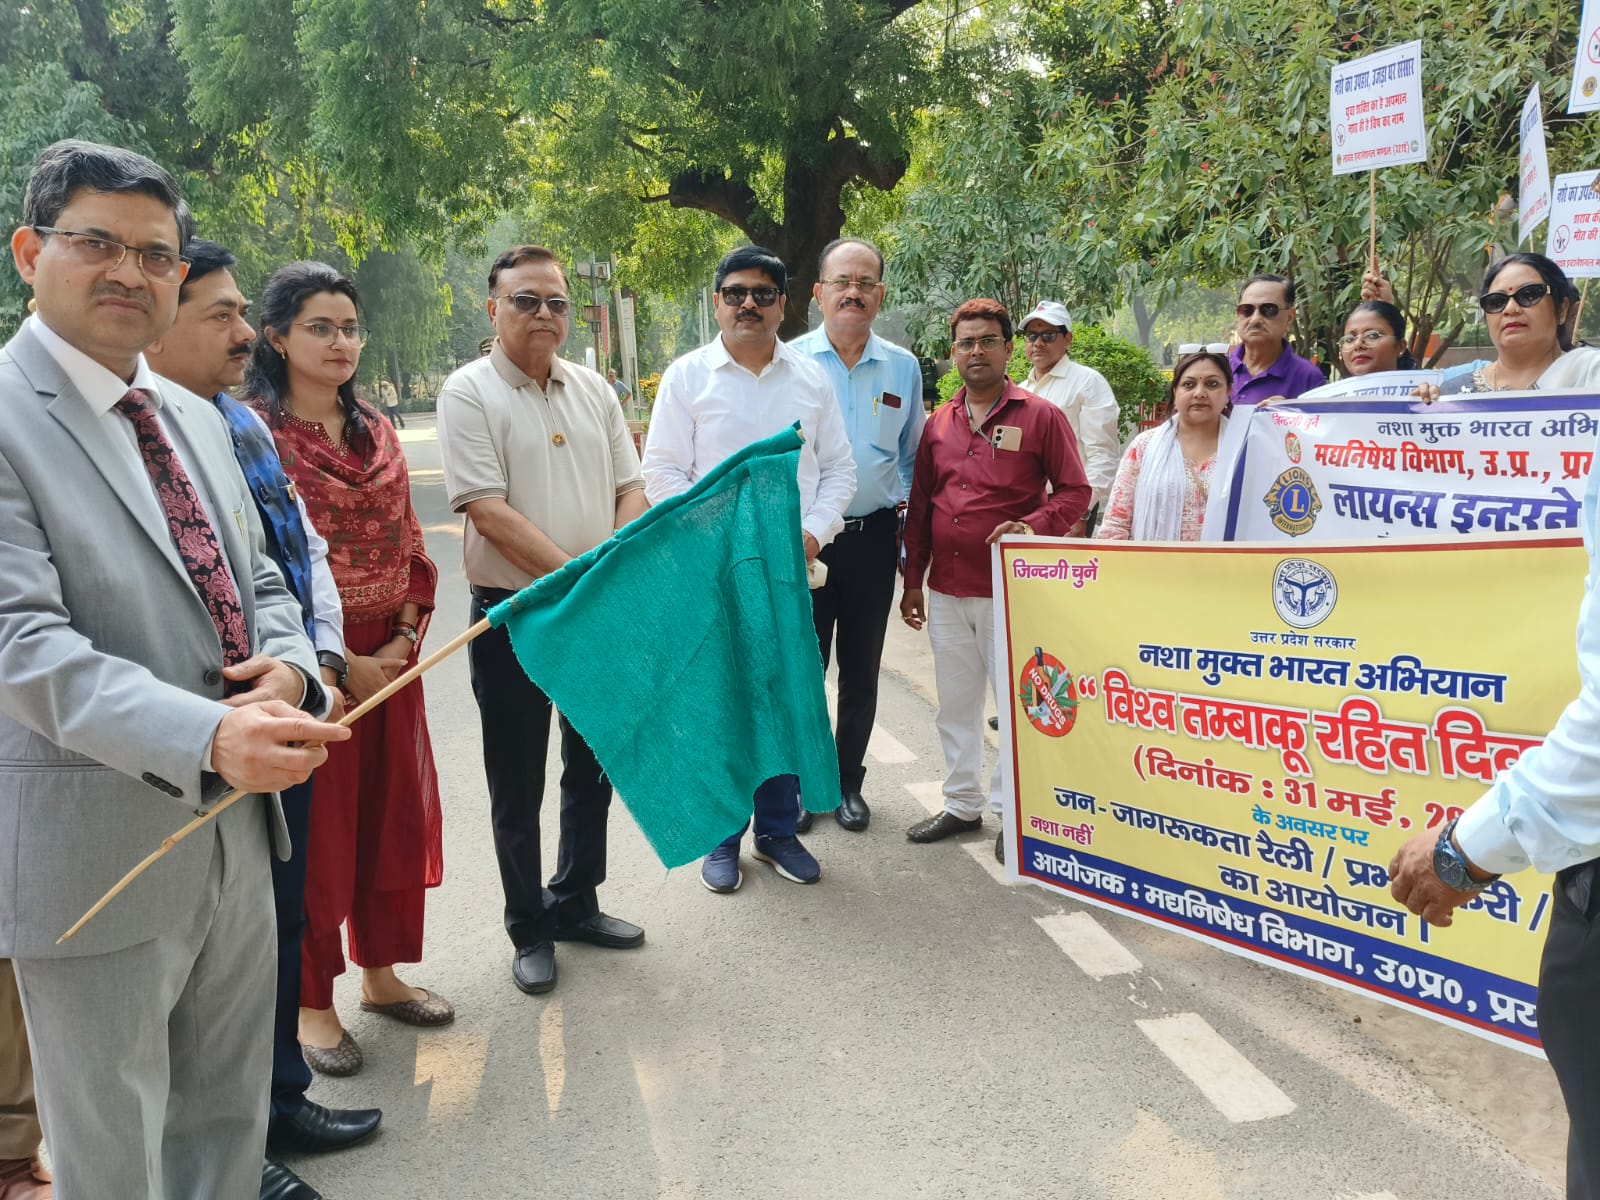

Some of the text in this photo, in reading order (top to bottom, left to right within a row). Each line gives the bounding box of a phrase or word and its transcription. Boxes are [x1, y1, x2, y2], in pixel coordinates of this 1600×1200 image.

[1345, 77, 1353, 92] का
[1568, 186, 1579, 202] का
[1377, 412, 1599, 443] नशा मुक्त भारत अभि
[1329, 483, 1446, 529] लायन्स
[1013, 557, 1098, 588] जिन्दगी चुनें
[1250, 630, 1356, 650] उत्तर प्रदेश सरकार
[1139, 644, 1507, 702] नशा मुक्त भारत अभियान
[1029, 668, 1066, 725] NO DRUGS
[1180, 696, 1308, 774] तम्बाकू
[1314, 699, 1427, 771] रहित
[1434, 710, 1544, 780] दिव
[1283, 779, 1317, 808] 31
[1030, 816, 1094, 845] नशा नहीं
[1251, 803, 1369, 847] के अवसर पर
[1256, 830, 1314, 872] रैली
[1032, 851, 1126, 895] आयोजक
[1144, 884, 1254, 938] मद्यनिषेध
[1218, 865, 1259, 895] का
[1265, 884, 1407, 936] आयोजन
